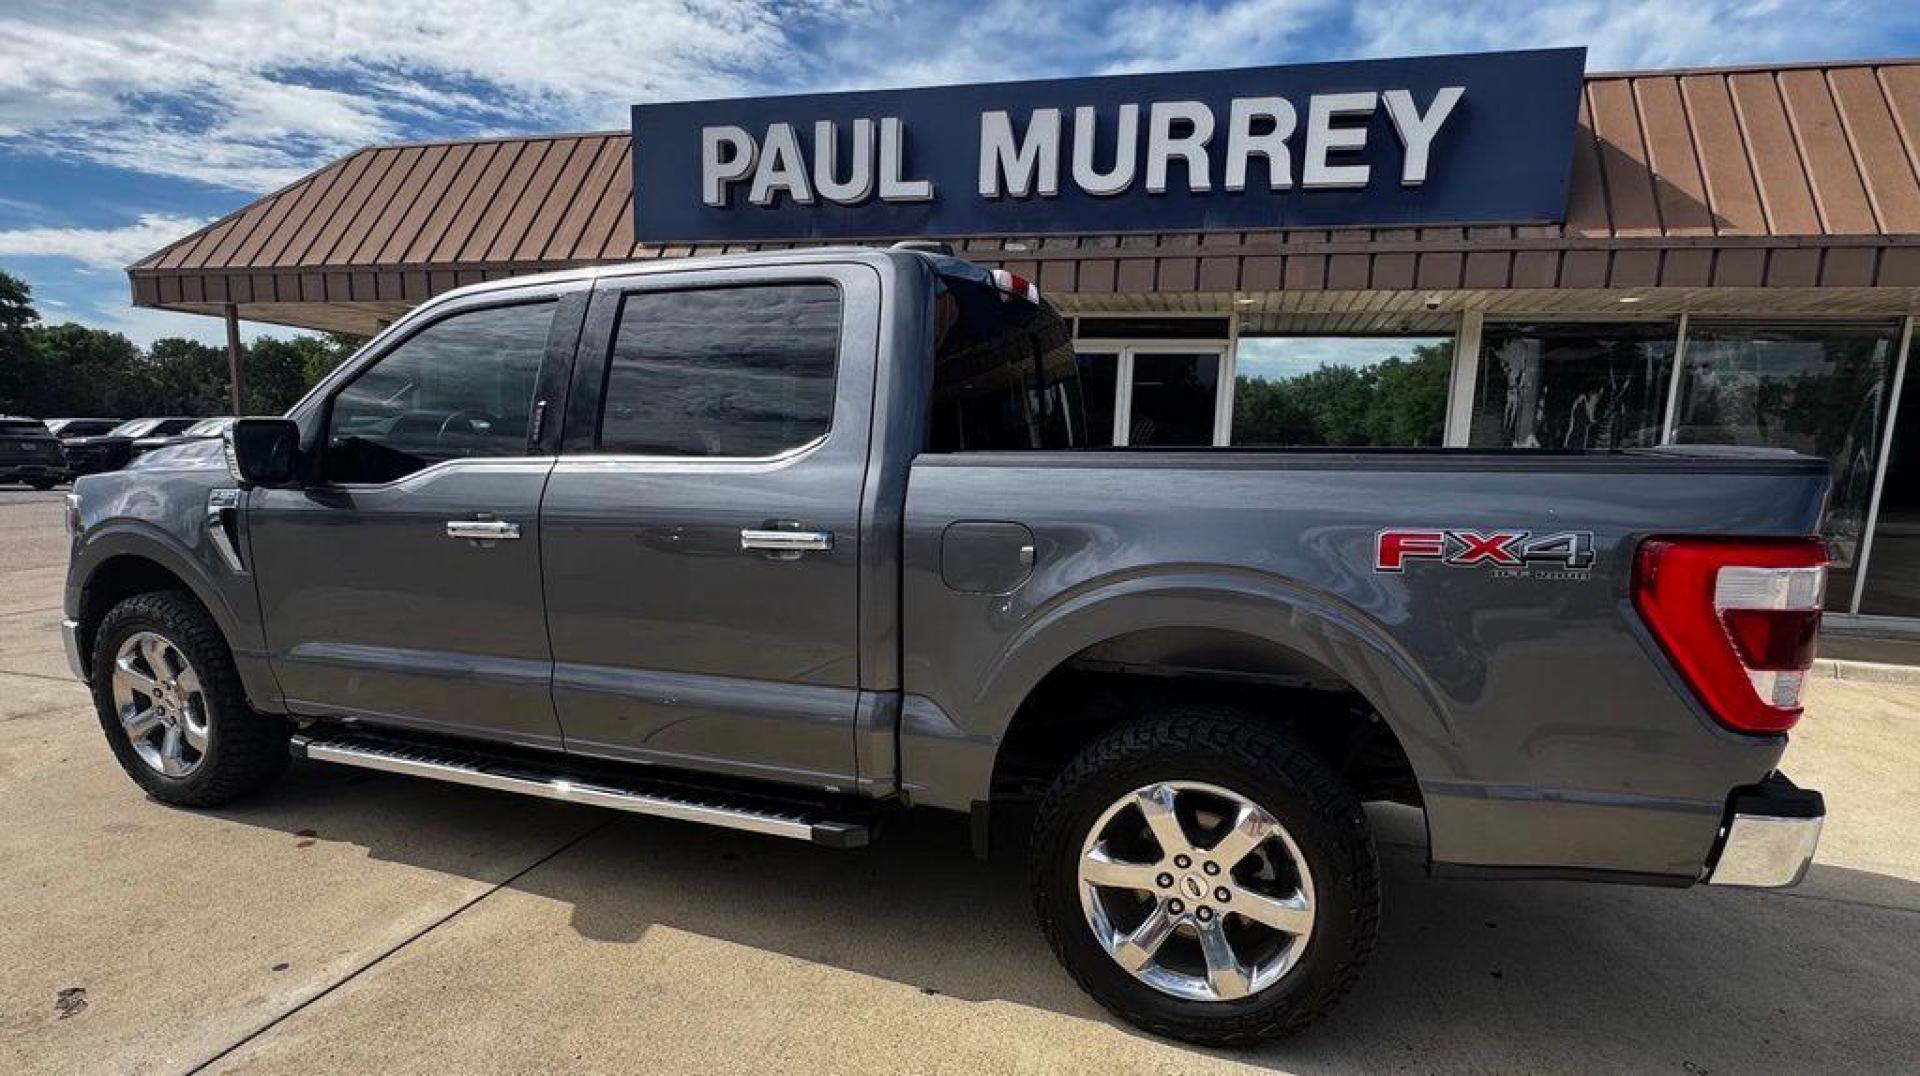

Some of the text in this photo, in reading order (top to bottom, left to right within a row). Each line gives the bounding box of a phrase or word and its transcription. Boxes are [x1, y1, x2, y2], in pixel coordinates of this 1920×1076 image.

[701, 85, 1466, 207] PAUL MURREY
[1374, 530, 1596, 573] FX4
